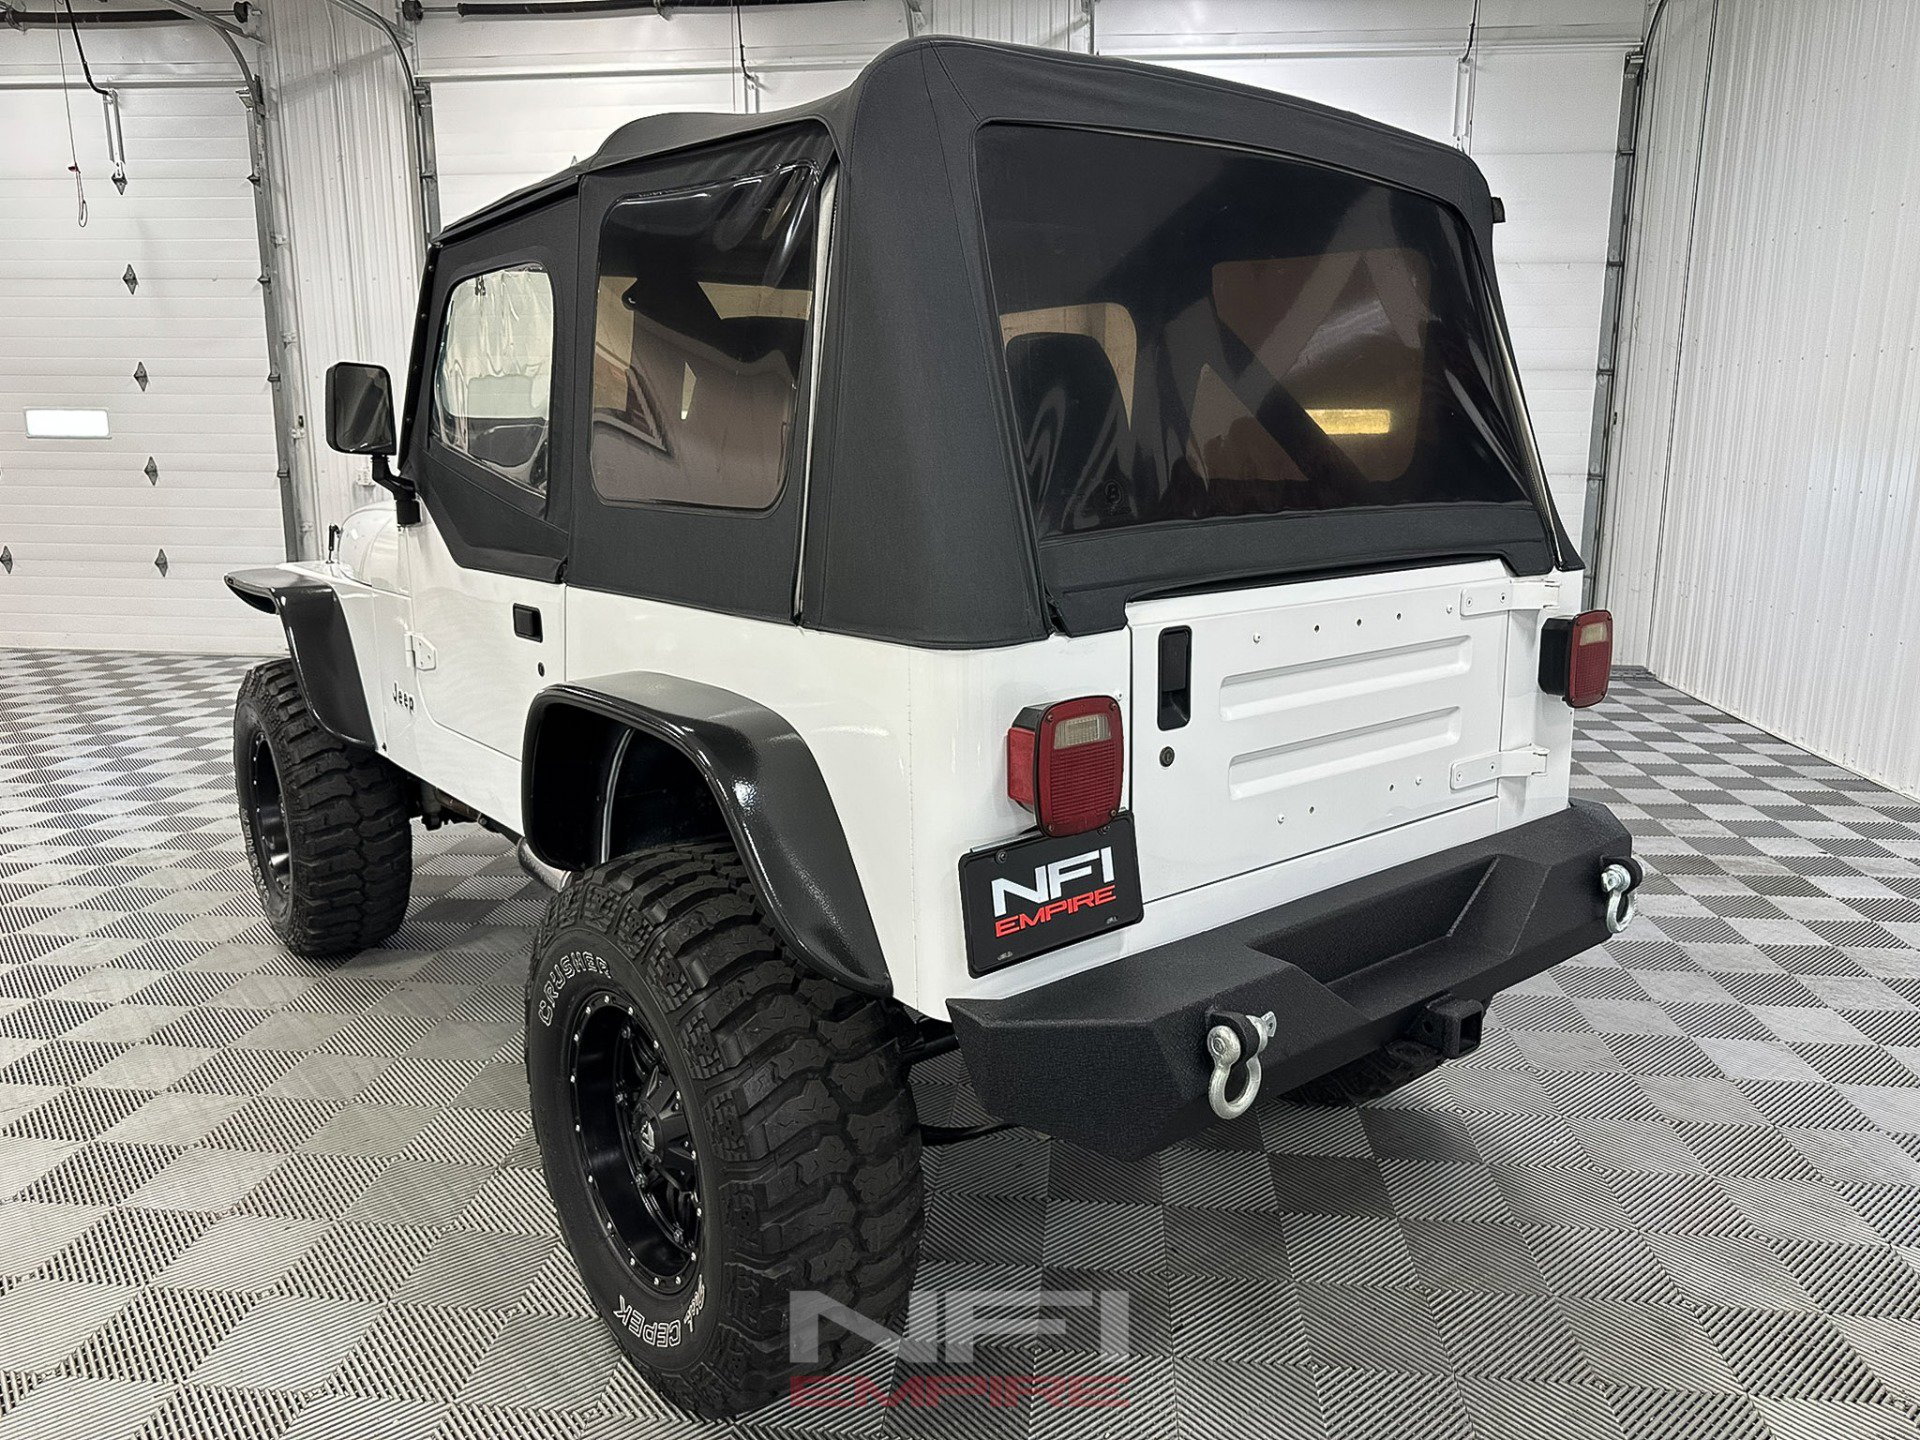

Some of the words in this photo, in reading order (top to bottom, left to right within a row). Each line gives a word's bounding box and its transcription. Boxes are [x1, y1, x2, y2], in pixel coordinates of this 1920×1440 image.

[393, 682, 415, 715] Jeep
[991, 846, 1115, 917] NFI
[994, 884, 1117, 938] EMPIRE
[538, 951, 612, 1027] CRUSHER
[613, 1294, 681, 1348] CEPEK
